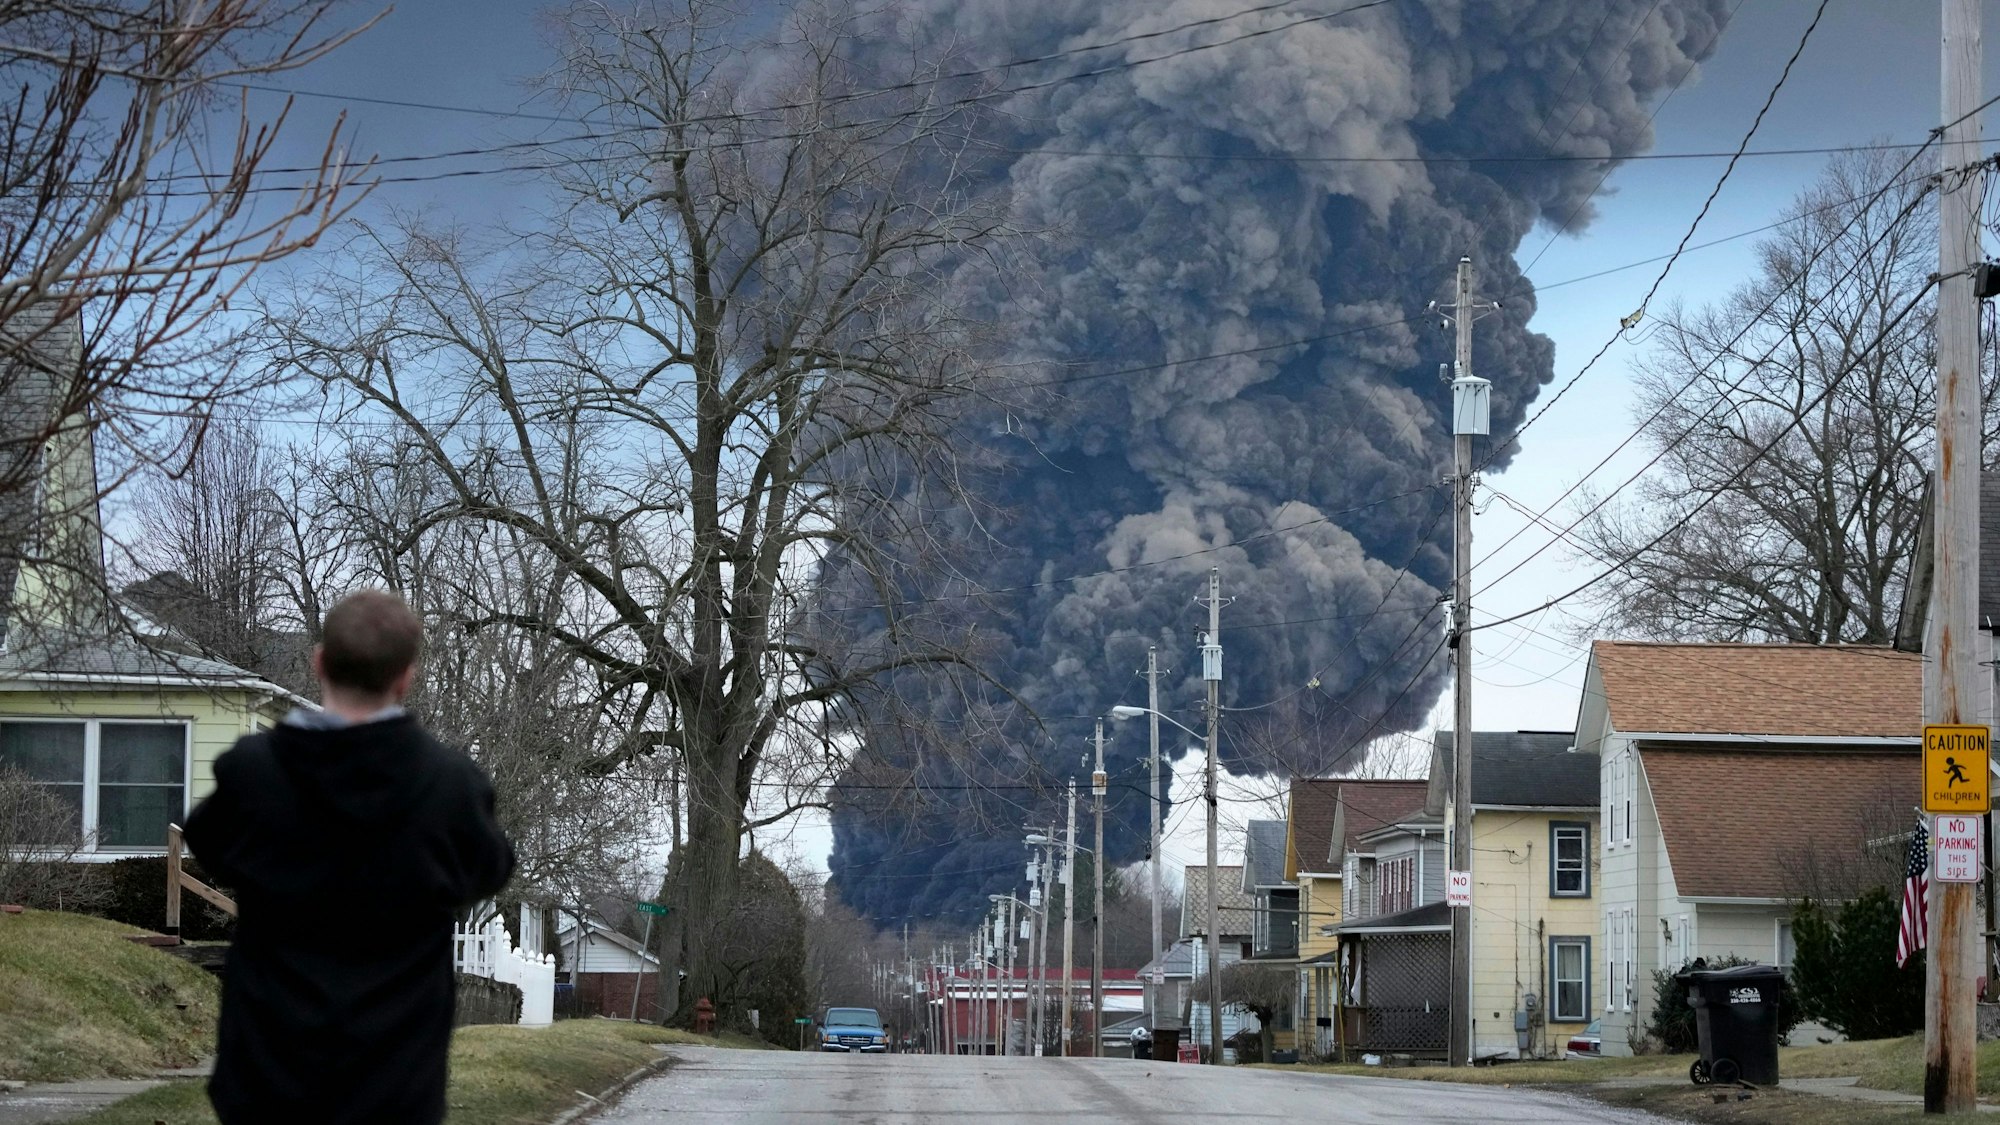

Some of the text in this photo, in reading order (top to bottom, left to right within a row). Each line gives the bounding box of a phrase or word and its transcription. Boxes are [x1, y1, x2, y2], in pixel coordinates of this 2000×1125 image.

[1929, 735, 1985, 751] CAUTION
[1933, 792, 1981, 801] CHILDREN
[1949, 821, 1965, 833] NO
[1938, 838, 1976, 850] PARKING
[1947, 854, 1967, 863] THIS
[1947, 867, 1968, 876] SIDE
[1453, 877, 1467, 886] NO
[1450, 893, 1470, 901] PARKING
[639, 904, 652, 912] EAST
